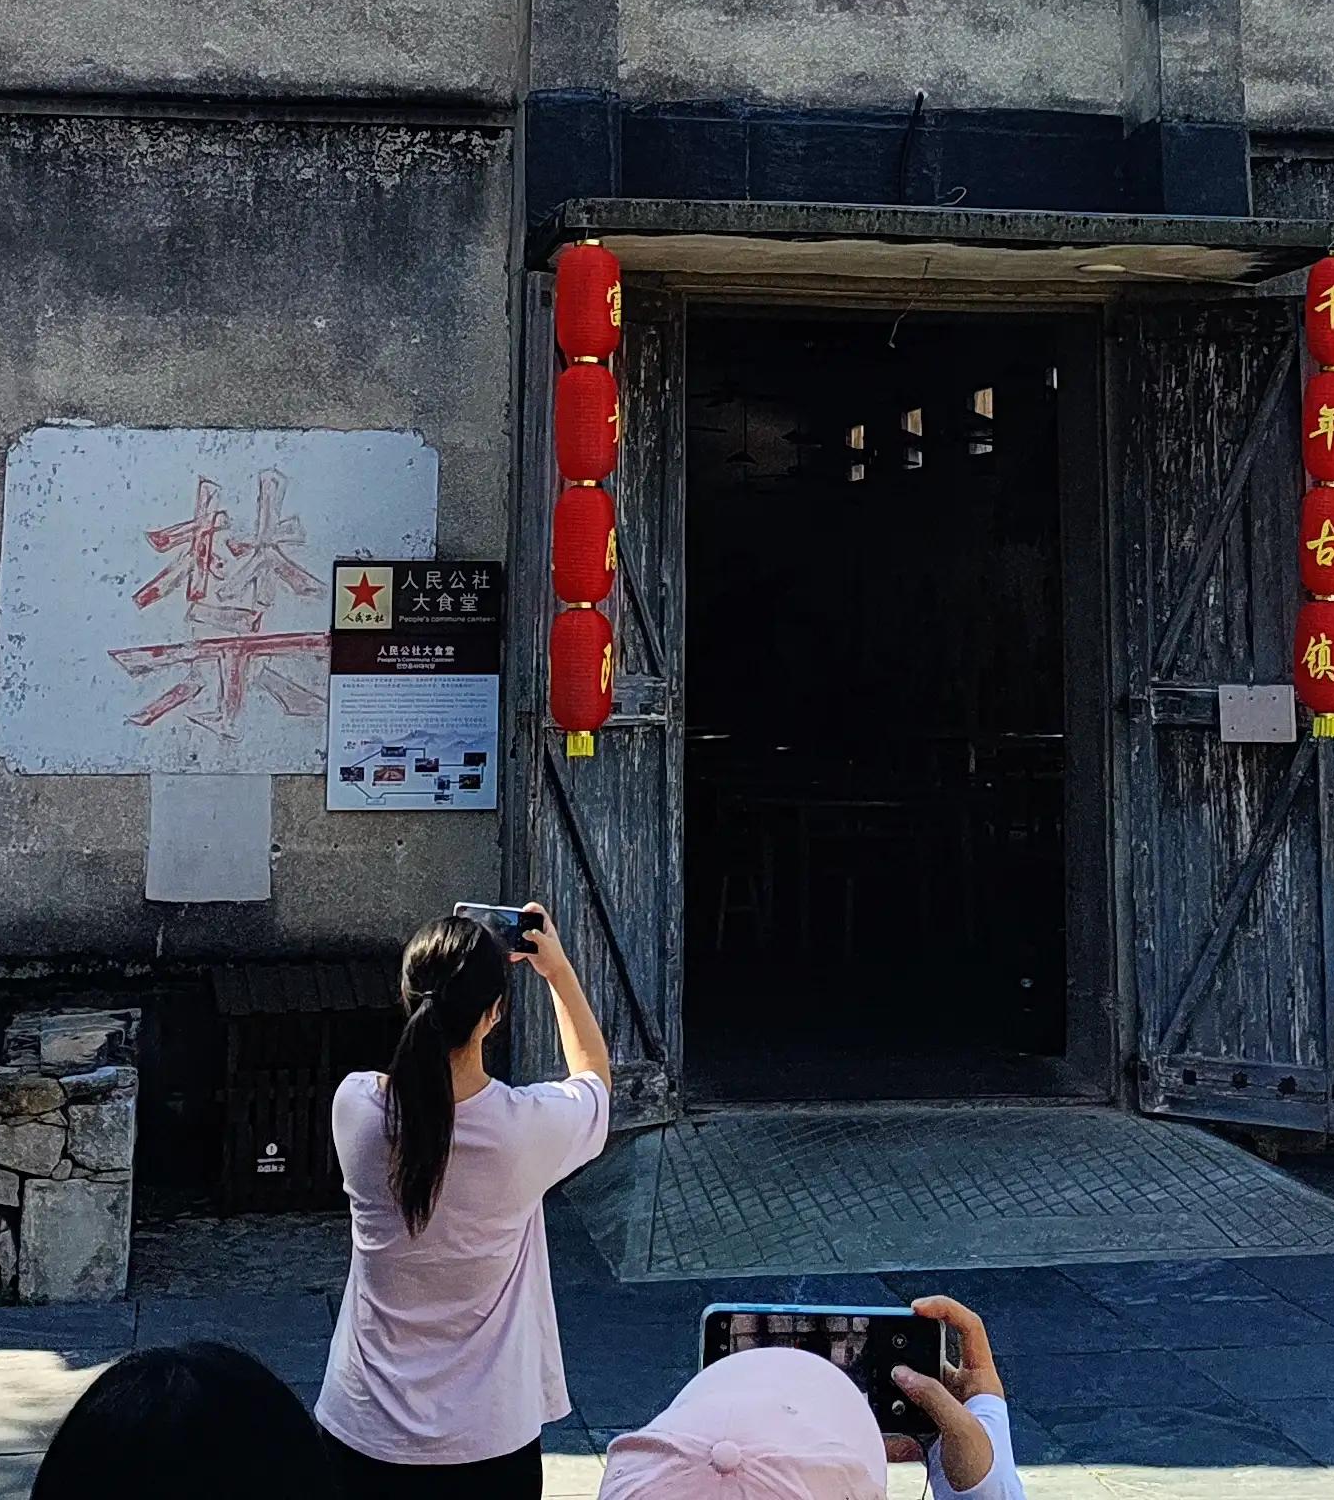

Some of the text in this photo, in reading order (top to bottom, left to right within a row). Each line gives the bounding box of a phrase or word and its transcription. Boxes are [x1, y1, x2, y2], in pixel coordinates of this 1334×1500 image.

[400, 570, 490, 590] 人民公社
[107, 467, 333, 743] 禁
[411, 592, 479, 612] 大食堂
[398, 615, 430, 624] People's
[377, 645, 455, 656] 人民公社大食堂
